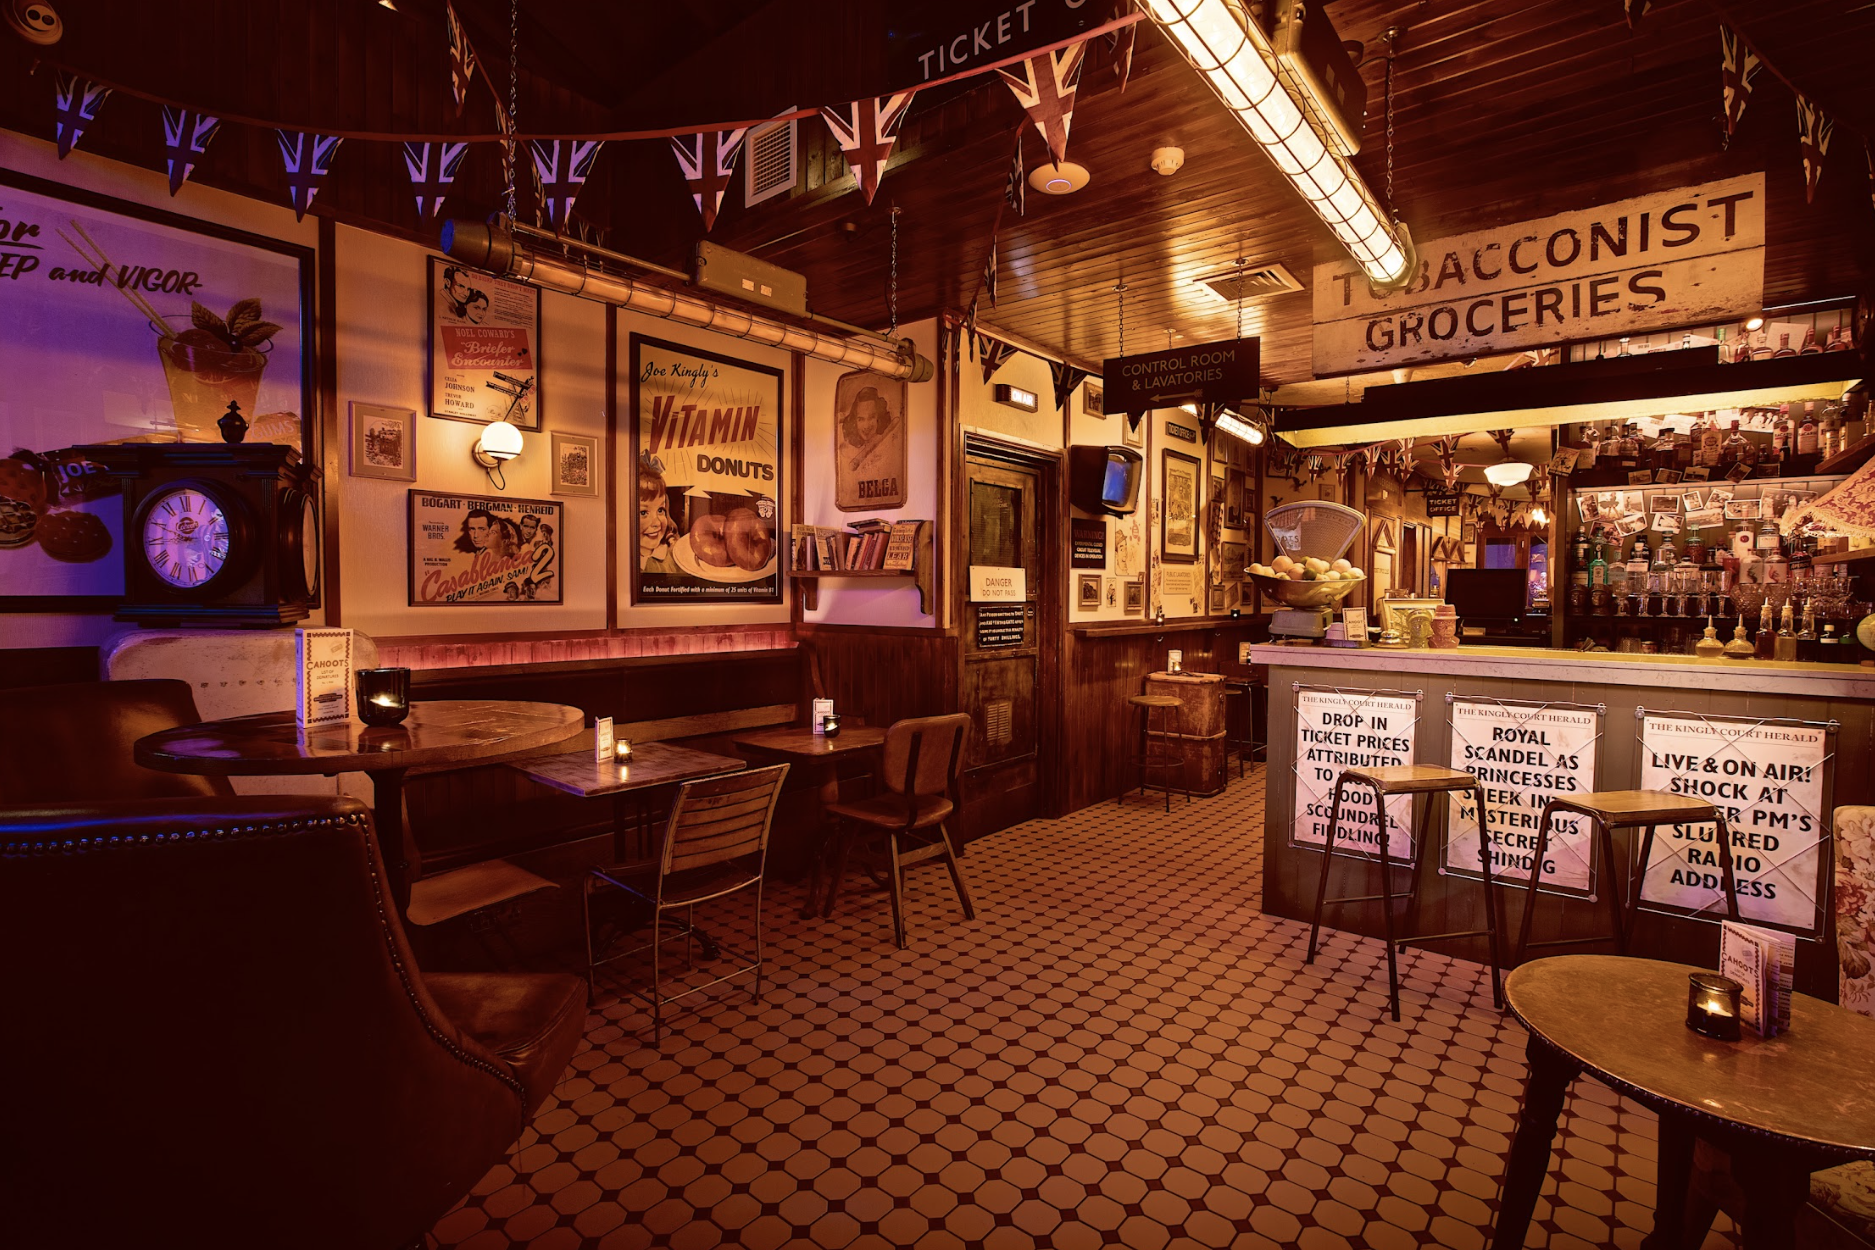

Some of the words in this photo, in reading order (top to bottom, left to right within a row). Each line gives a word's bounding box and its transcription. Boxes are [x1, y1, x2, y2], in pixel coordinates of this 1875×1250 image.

[918, 0, 1036, 80] TICKET
[49, 263, 111, 287] and
[1365, 270, 1666, 353] GROCERIES
[455, 328, 476, 338] NOEL
[477, 329, 515, 339] COWARD'S
[451, 352, 524, 367] Encounter
[1122, 358, 1186, 377] CONTROL
[1191, 350, 1235, 367] ROOM
[641, 361, 666, 384] Joe
[671, 363, 719, 388] Kingly's
[1132, 380, 1141, 391] &
[1145, 368, 1223, 389] LAVATORIES
[444, 382, 475, 393] JOHNSON
[444, 399, 475, 409] HOWARD
[696, 454, 774, 482] DONUTS
[858, 477, 899, 499] BELGA
[422, 497, 461, 510] BOGART
[467, 500, 513, 513] BERGMAN
[518, 504, 554, 516] HENREID
[422, 524, 449, 532] WARNER
[531, 542, 555, 585] 2
[446, 588, 469, 603] PLAY
[506, 566, 529, 581] SAM!
[643, 585, 655, 593] Each
[670, 586, 690, 594] Fortified
[982, 589, 991, 597] DO
[992, 589, 1003, 597] NOT
[1005, 589, 1016, 597] PASS
[985, 577, 1013, 588] DANGER
[306, 659, 349, 671] CAHOOTS
[1319, 697, 1346, 705] KINGLY
[1348, 699, 1376, 708] COURT
[1377, 702, 1412, 711] HERALD
[1322, 712, 1364, 728] DROP
[1371, 716, 1388, 731] IN
[1457, 707, 1477, 716] THE
[1478, 709, 1511, 719] KINGLY
[1514, 712, 1547, 722] COURT
[1549, 715, 1591, 725] HERALD
[1301, 729, 1352, 746] TICKET
[1357, 734, 1410, 752] PRICES
[1492, 727, 1551, 746] ROYAL
[1649, 722, 1674, 732] THE
[1675, 724, 1717, 735] KINGLY
[1720, 728, 1762, 739] COURT
[1764, 731, 1818, 743] HERALD
[1307, 748, 1402, 767] ATTRIBUTED
[1465, 745, 1548, 767] SCANDEL
[1556, 754, 1579, 770] AS
[1652, 752, 1699, 772] LIVE
[1702, 757, 1719, 774] &
[1722, 759, 1756, 778] ON
[1762, 763, 1812, 783] AIR!
[1314, 767, 1333, 781] TO
[1466, 765, 1577, 792] PRINCESSES
[1463, 788, 1522, 807] SEEK
[1670, 776, 1749, 801] SHOCK
[1758, 786, 1788, 804] AT
[1460, 806, 1579, 835] MSTERIUS
[1752, 809, 1812, 832] PM'S
[1313, 822, 1390, 847] FIDLING!
[1477, 849, 1556, 874] SHINDG
[1721, 952, 1760, 979] CAHOOTS
